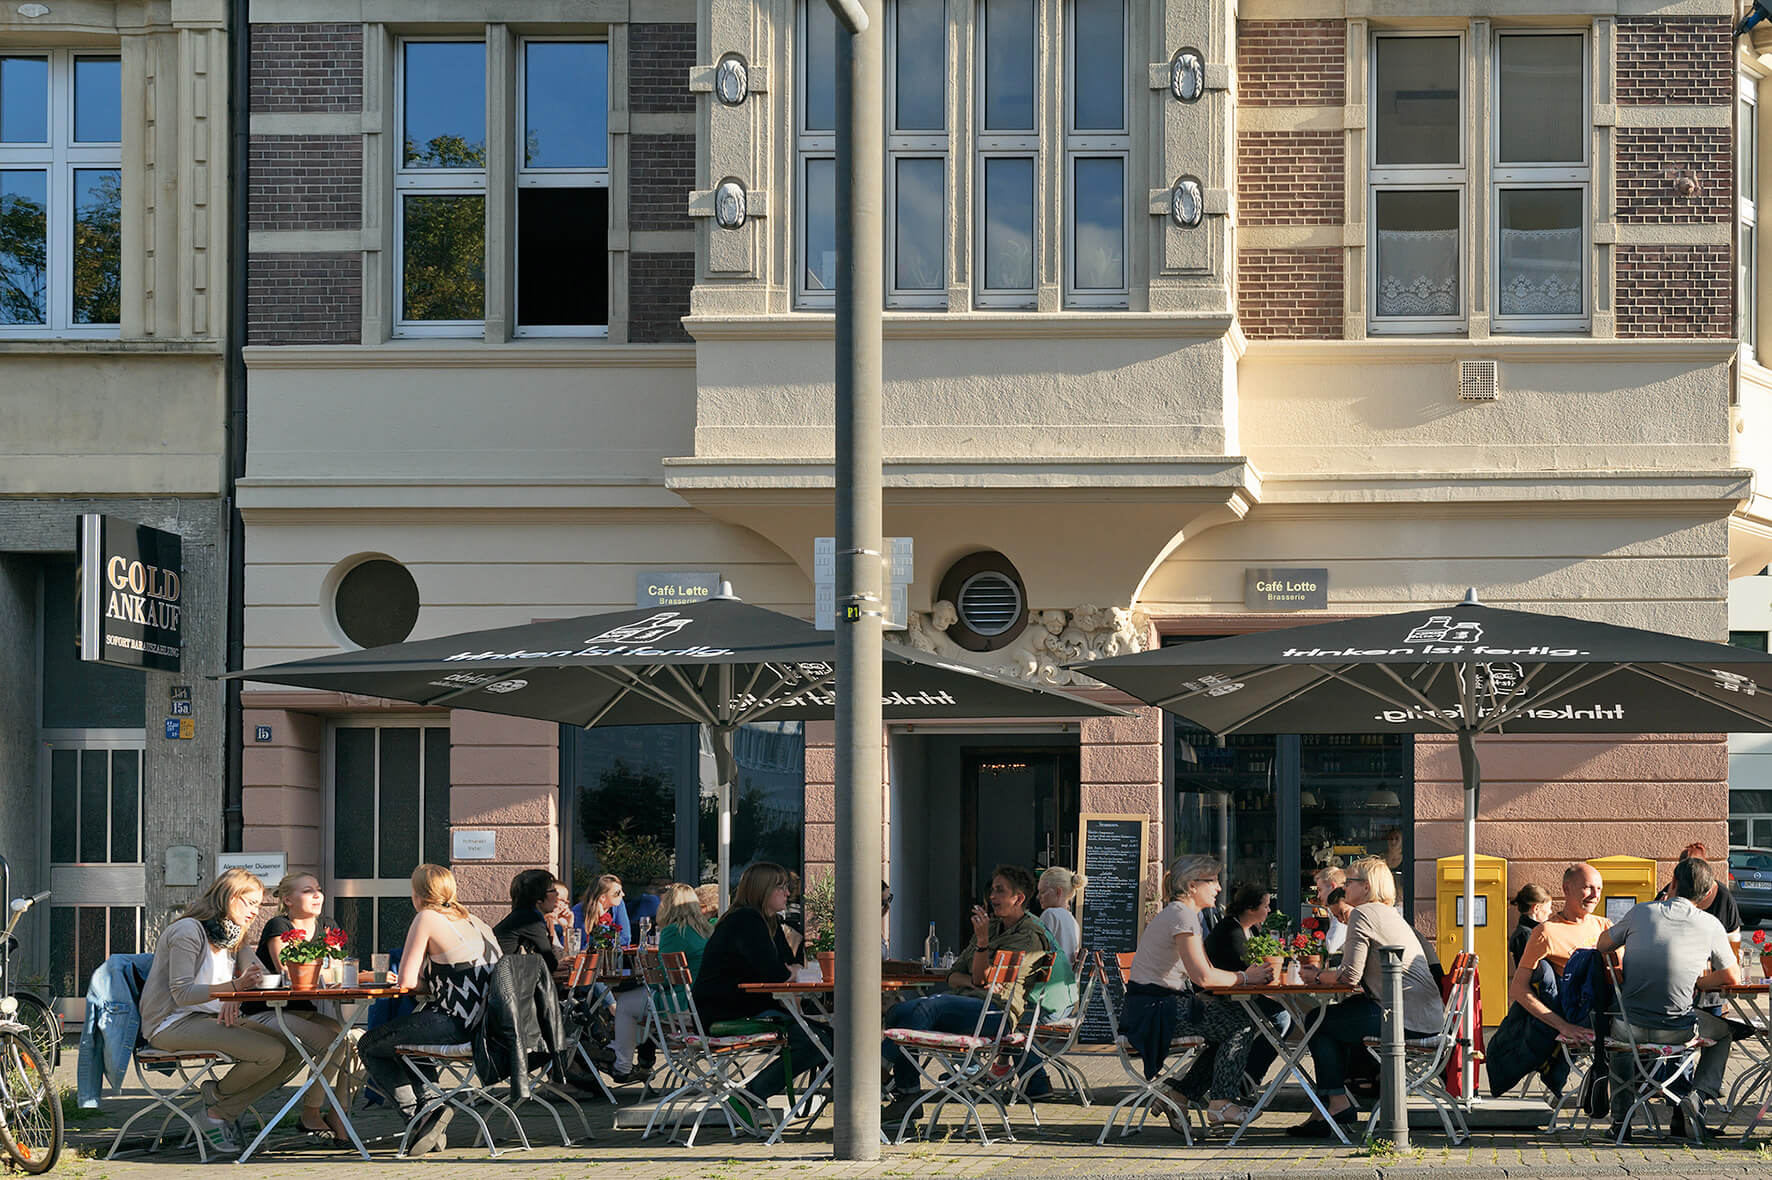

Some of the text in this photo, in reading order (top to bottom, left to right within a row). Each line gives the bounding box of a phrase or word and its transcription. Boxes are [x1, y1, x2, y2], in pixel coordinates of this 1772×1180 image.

[107, 555, 181, 602] GOLD
[648, 584, 709, 596] Café Lotte
[1256, 581, 1317, 593] Café Lotte
[1267, 593, 1305, 601] Brasserie
[106, 590, 181, 632] ANKAUF
[847, 607, 859, 618] P1
[443, 650, 574, 662] trinken
[1282, 648, 1415, 657] trinken
[1422, 645, 1466, 655] ist
[173, 702, 189, 714] 15a
[257, 727, 270, 740] 15
